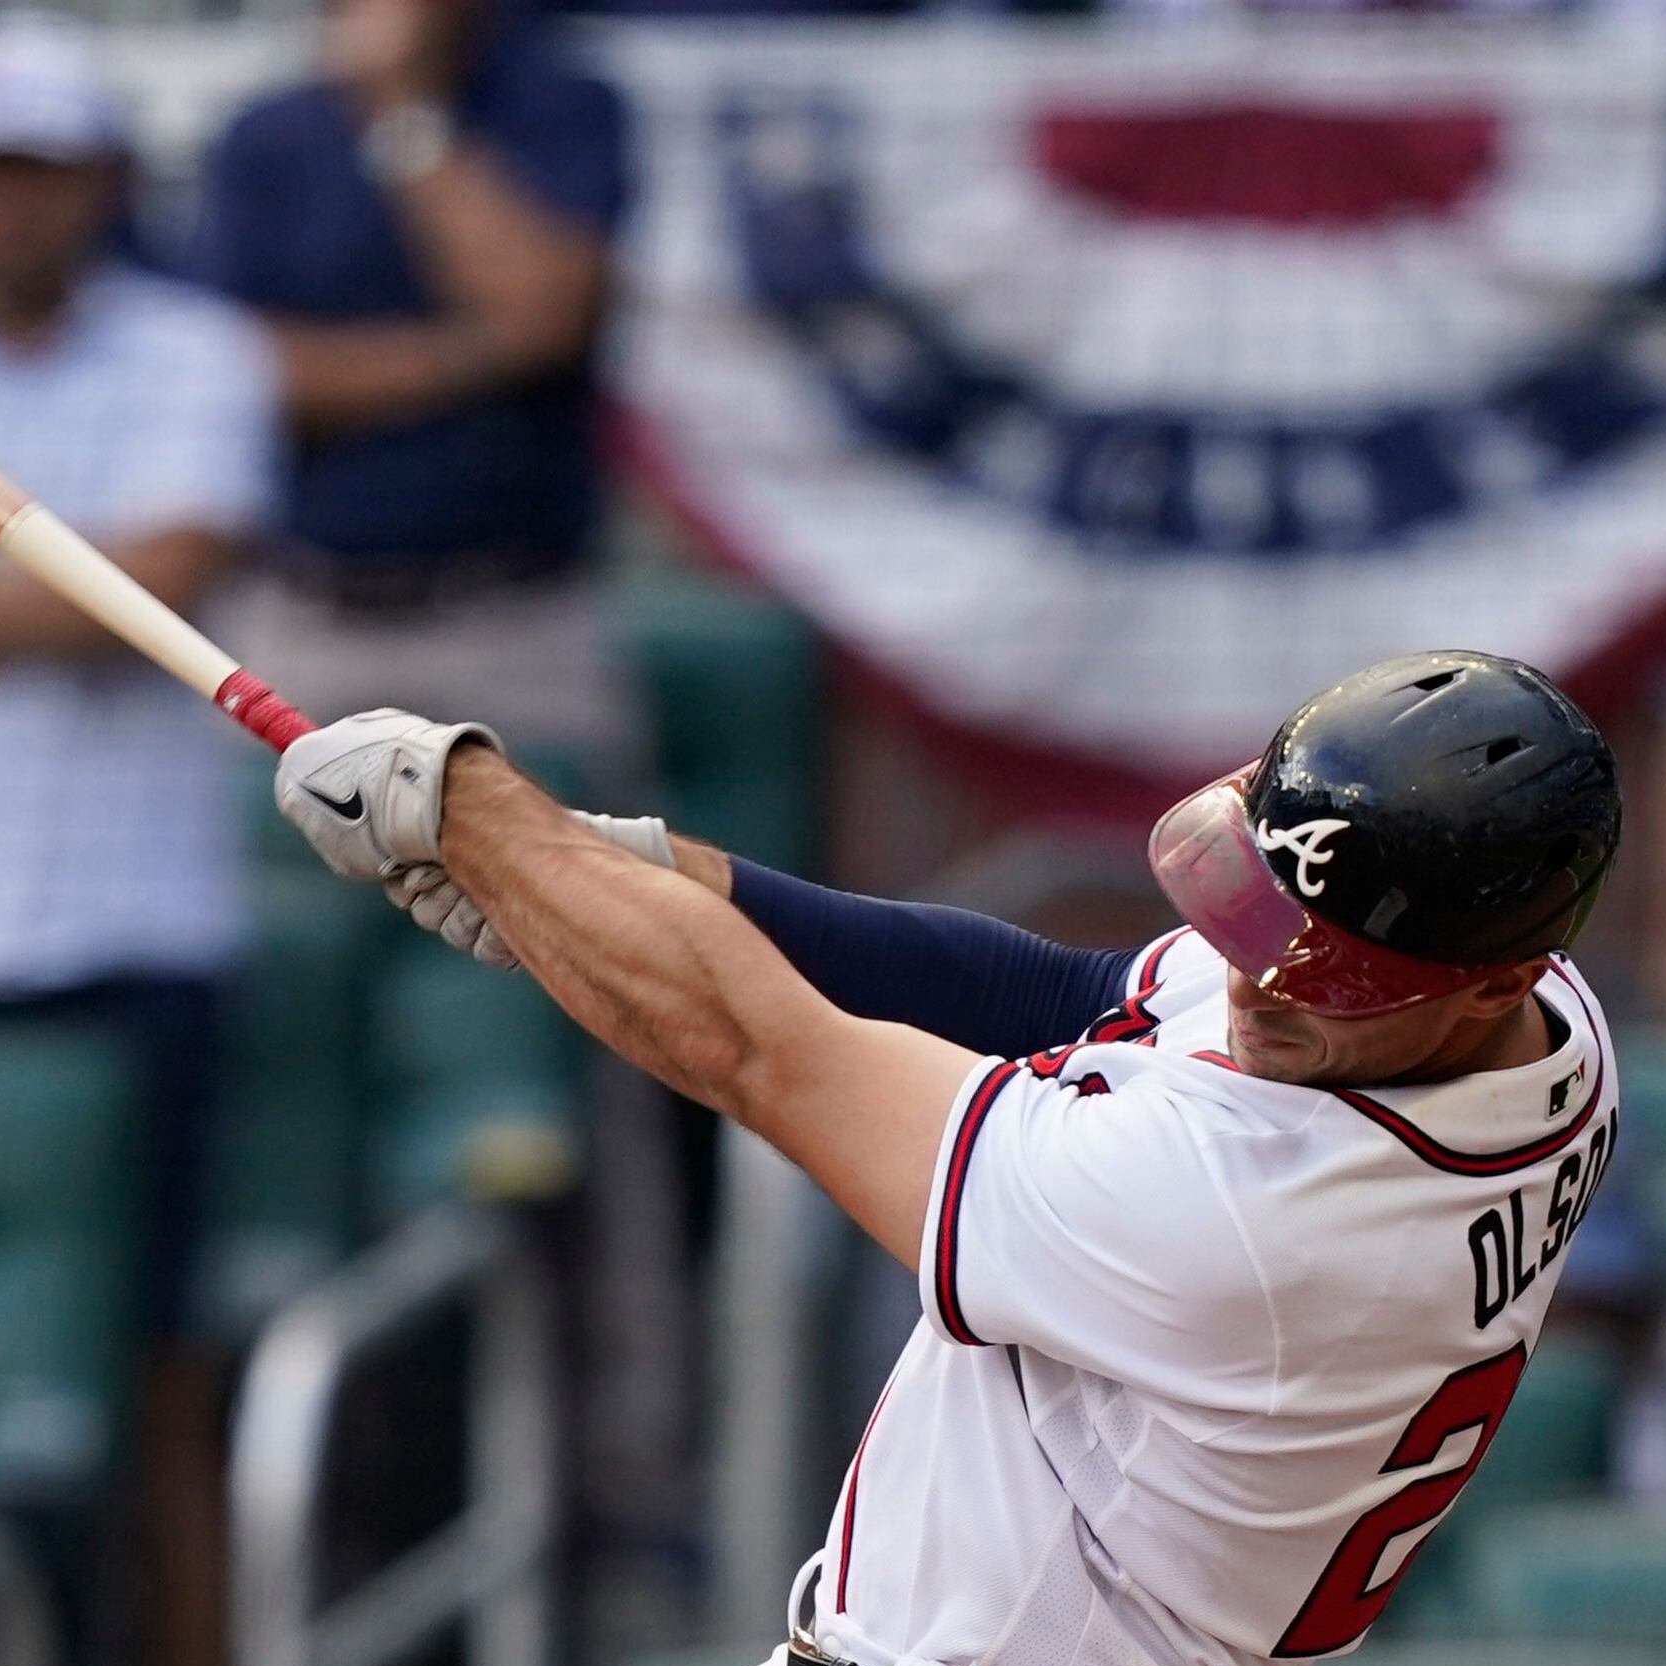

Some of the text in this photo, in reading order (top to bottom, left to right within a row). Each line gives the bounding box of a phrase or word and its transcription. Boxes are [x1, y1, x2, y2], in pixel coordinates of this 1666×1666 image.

[1257, 818, 1351, 897] A
[1468, 1106, 1619, 1330] OLSO
[1269, 1338, 1528, 1659] 2
